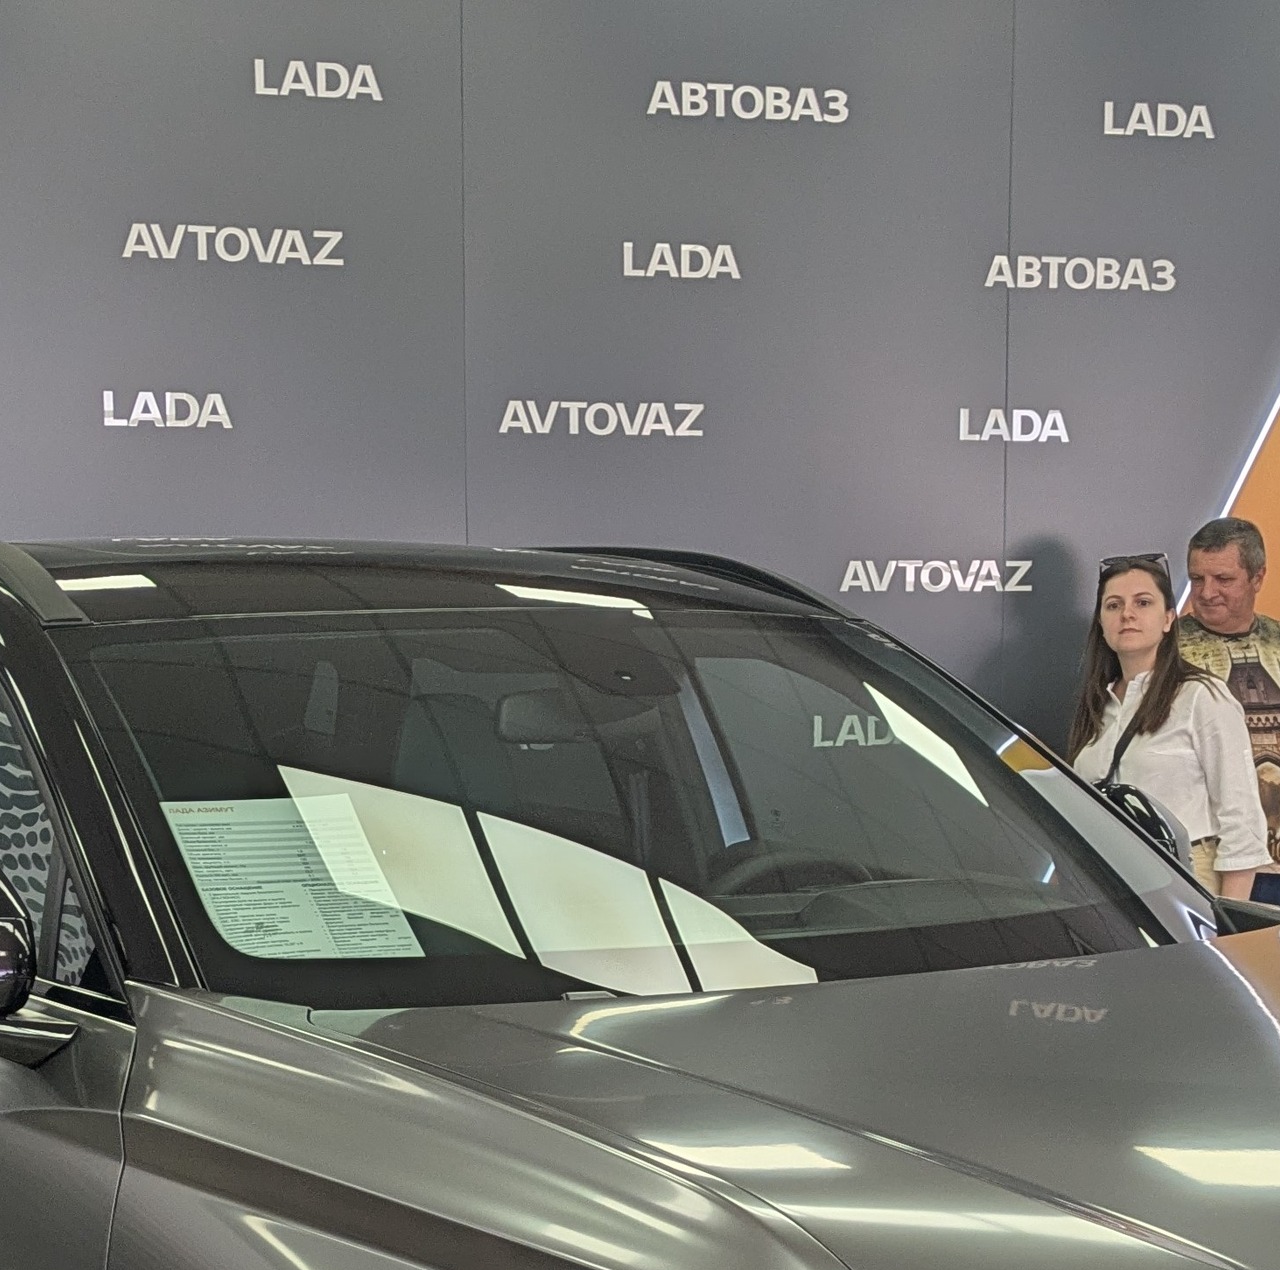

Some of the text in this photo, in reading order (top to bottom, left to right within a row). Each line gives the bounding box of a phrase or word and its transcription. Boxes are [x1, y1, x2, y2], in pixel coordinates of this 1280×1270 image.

[254, 58, 384, 101] LADA
[646, 80, 850, 123] АВТОВАЗ
[1103, 101, 1215, 139] LADA
[121, 223, 345, 266] AVTOVAZ
[623, 241, 741, 280] LADA
[984, 254, 1177, 292] АВТОВАЗ
[103, 390, 233, 430] LADA
[498, 400, 704, 437] AVTOVAZ
[959, 408, 1070, 443] LADA
[839, 559, 1033, 593] AVTOVAZ
[813, 714, 900, 748] LAD
